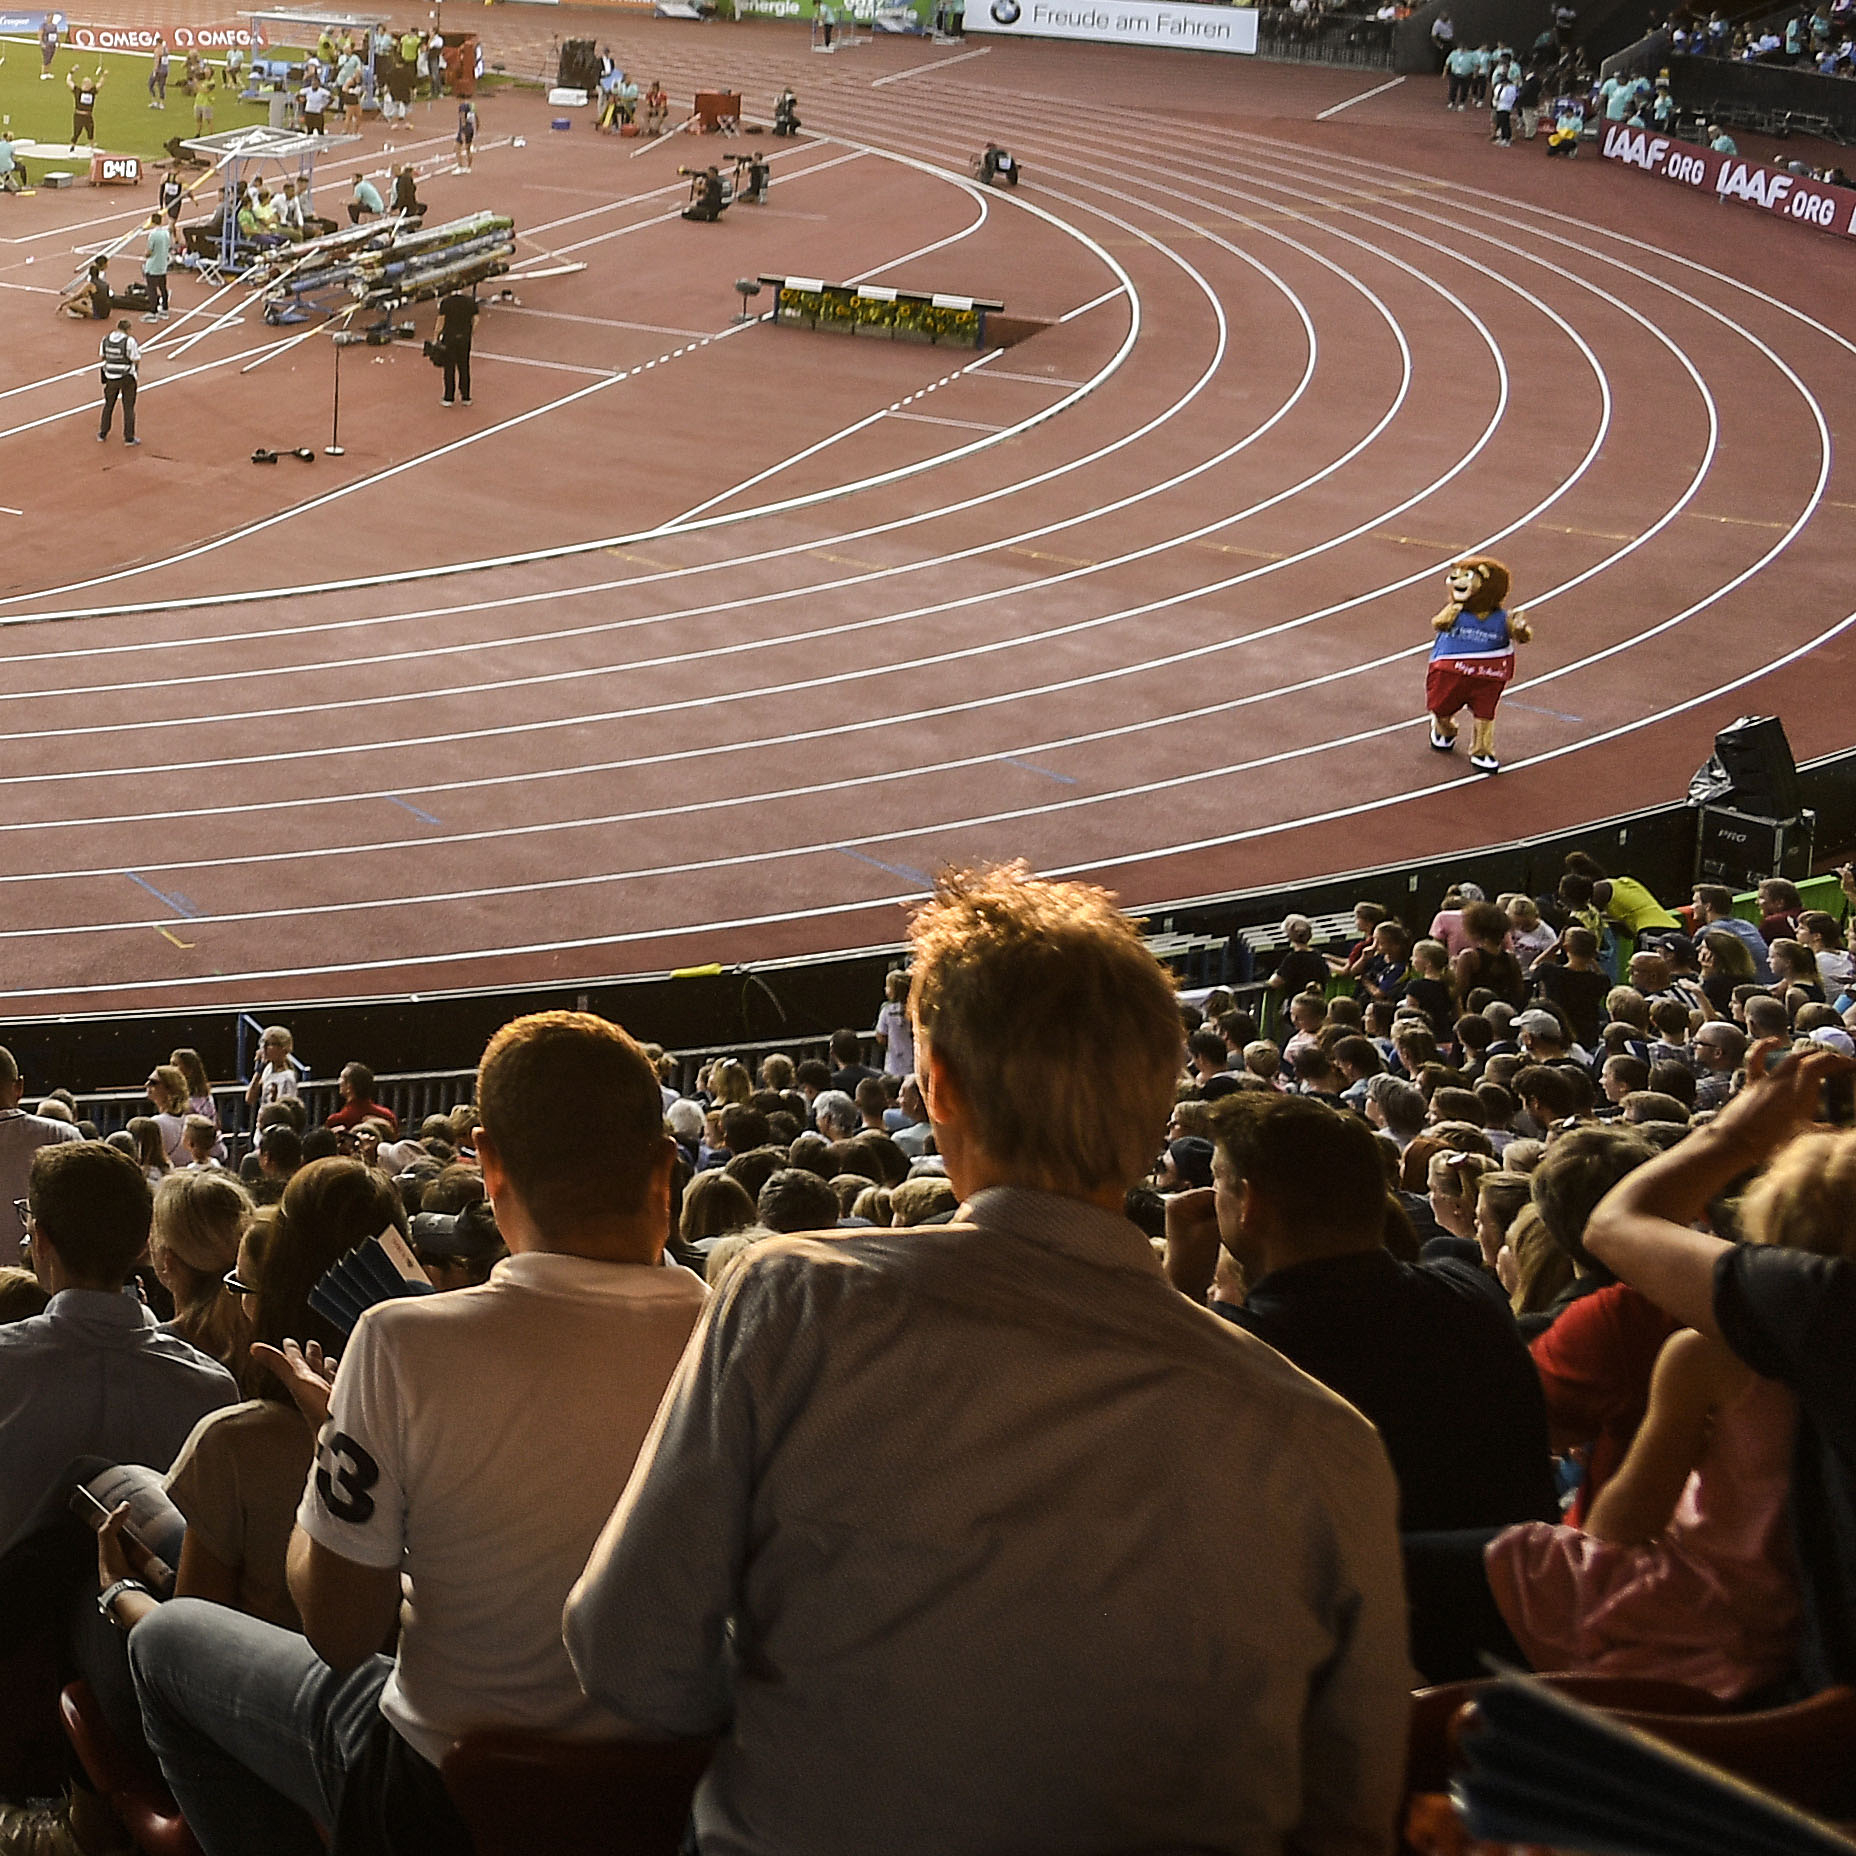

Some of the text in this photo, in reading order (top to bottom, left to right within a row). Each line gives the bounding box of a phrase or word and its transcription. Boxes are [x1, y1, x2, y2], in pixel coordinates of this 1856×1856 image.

[1032, 4, 1231, 40] Freude am Fahren
[1603, 124, 1705, 186] IAAF.ORG
[1716, 159, 1836, 226] IAAF.ORG
[316, 1431, 380, 1523] 3
